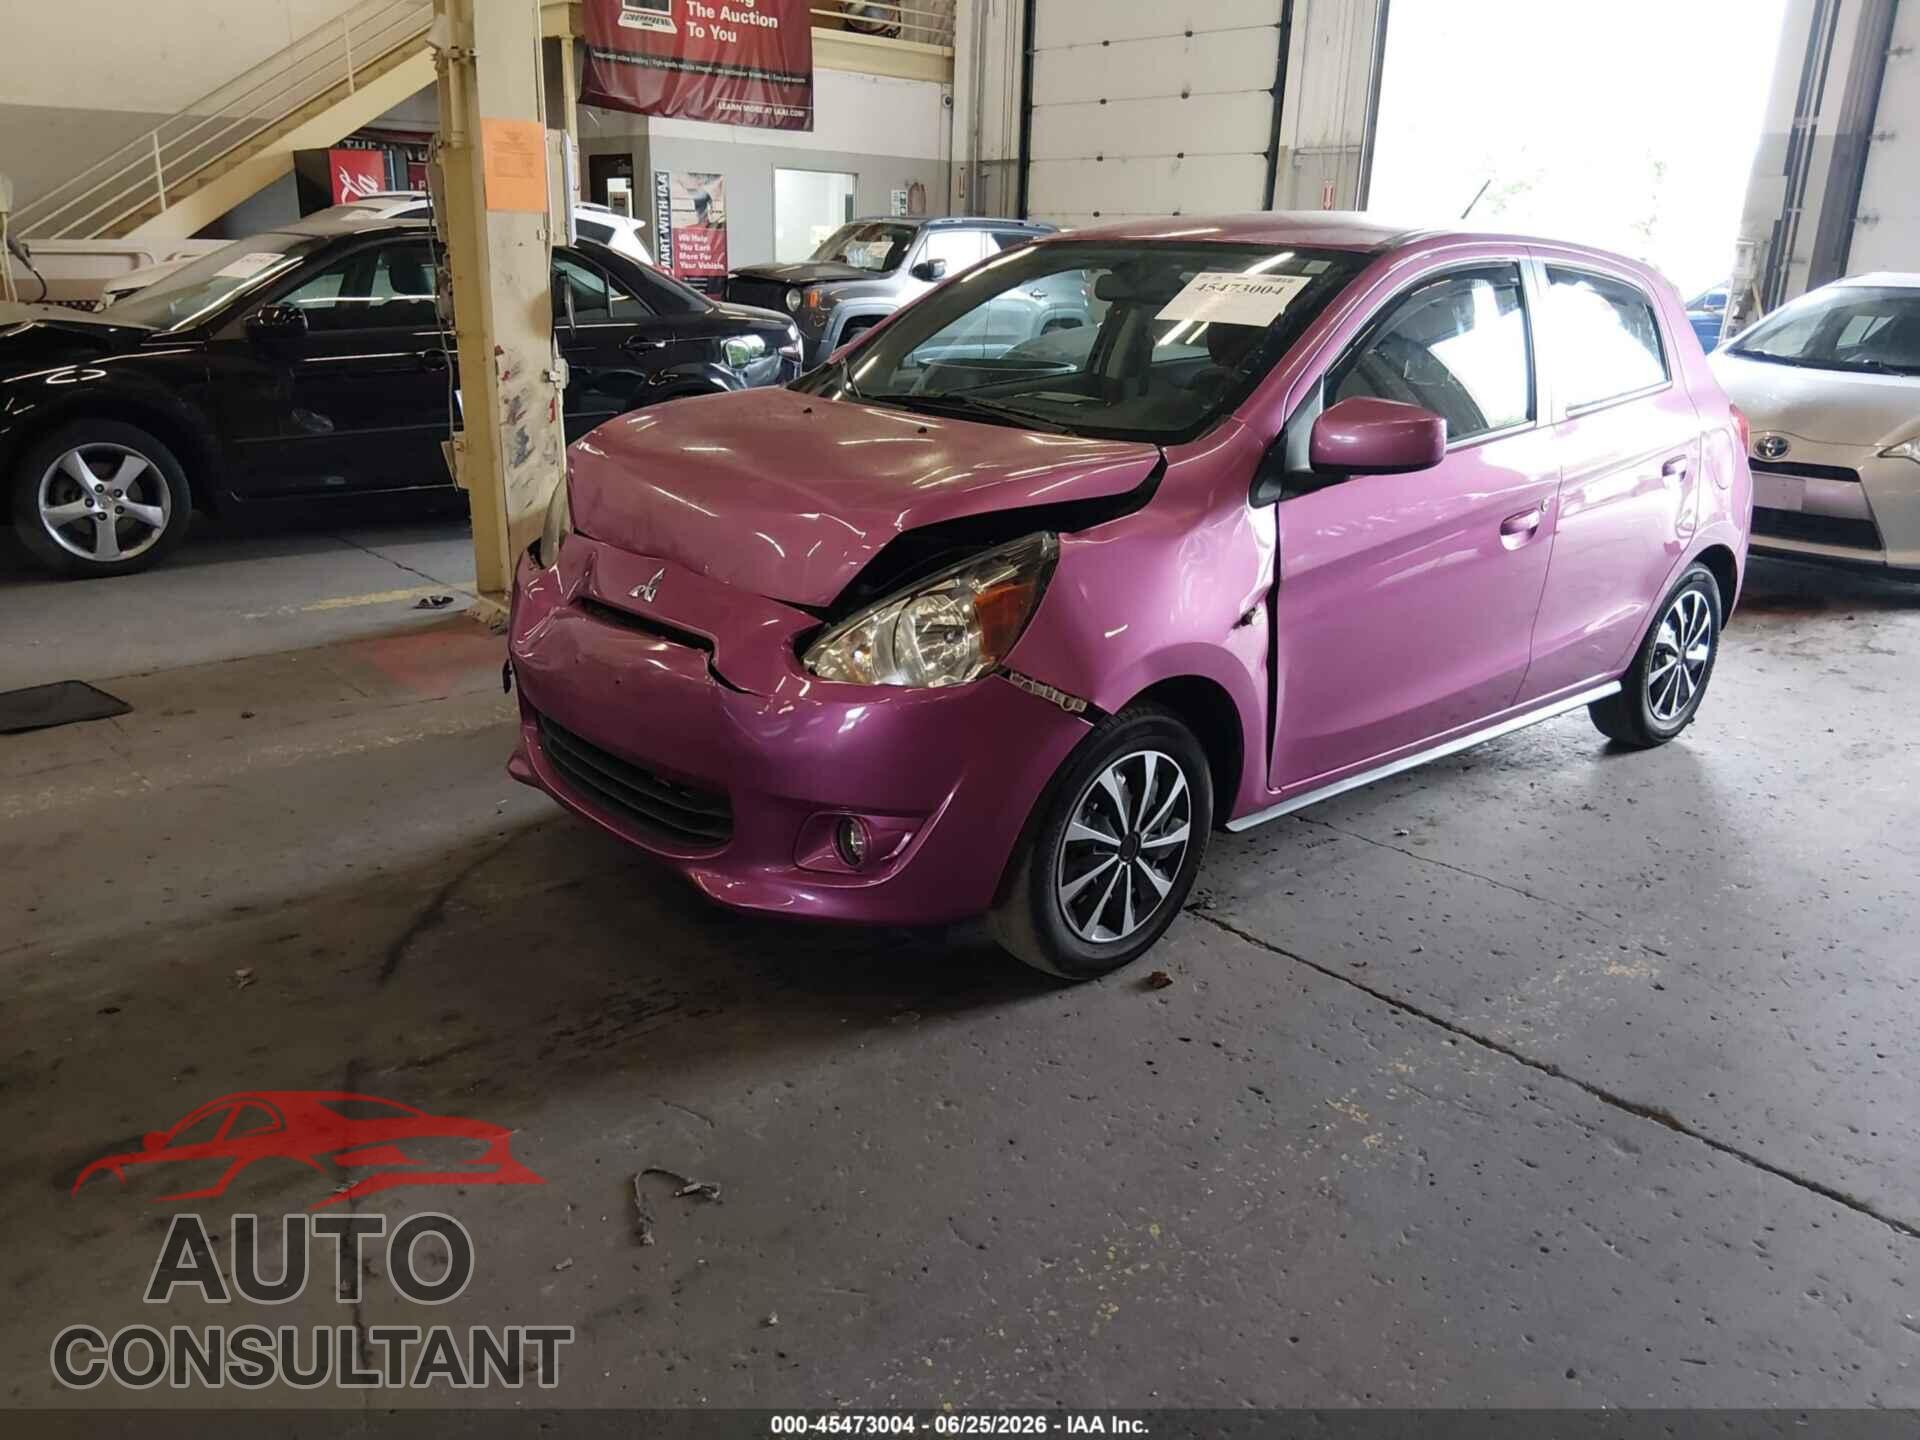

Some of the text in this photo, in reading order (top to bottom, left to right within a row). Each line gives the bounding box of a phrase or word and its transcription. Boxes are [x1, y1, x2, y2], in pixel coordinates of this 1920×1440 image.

[686, 0, 778, 28] The Auction
[686, 21, 737, 43] To You
[658, 199, 670, 234] WITH
